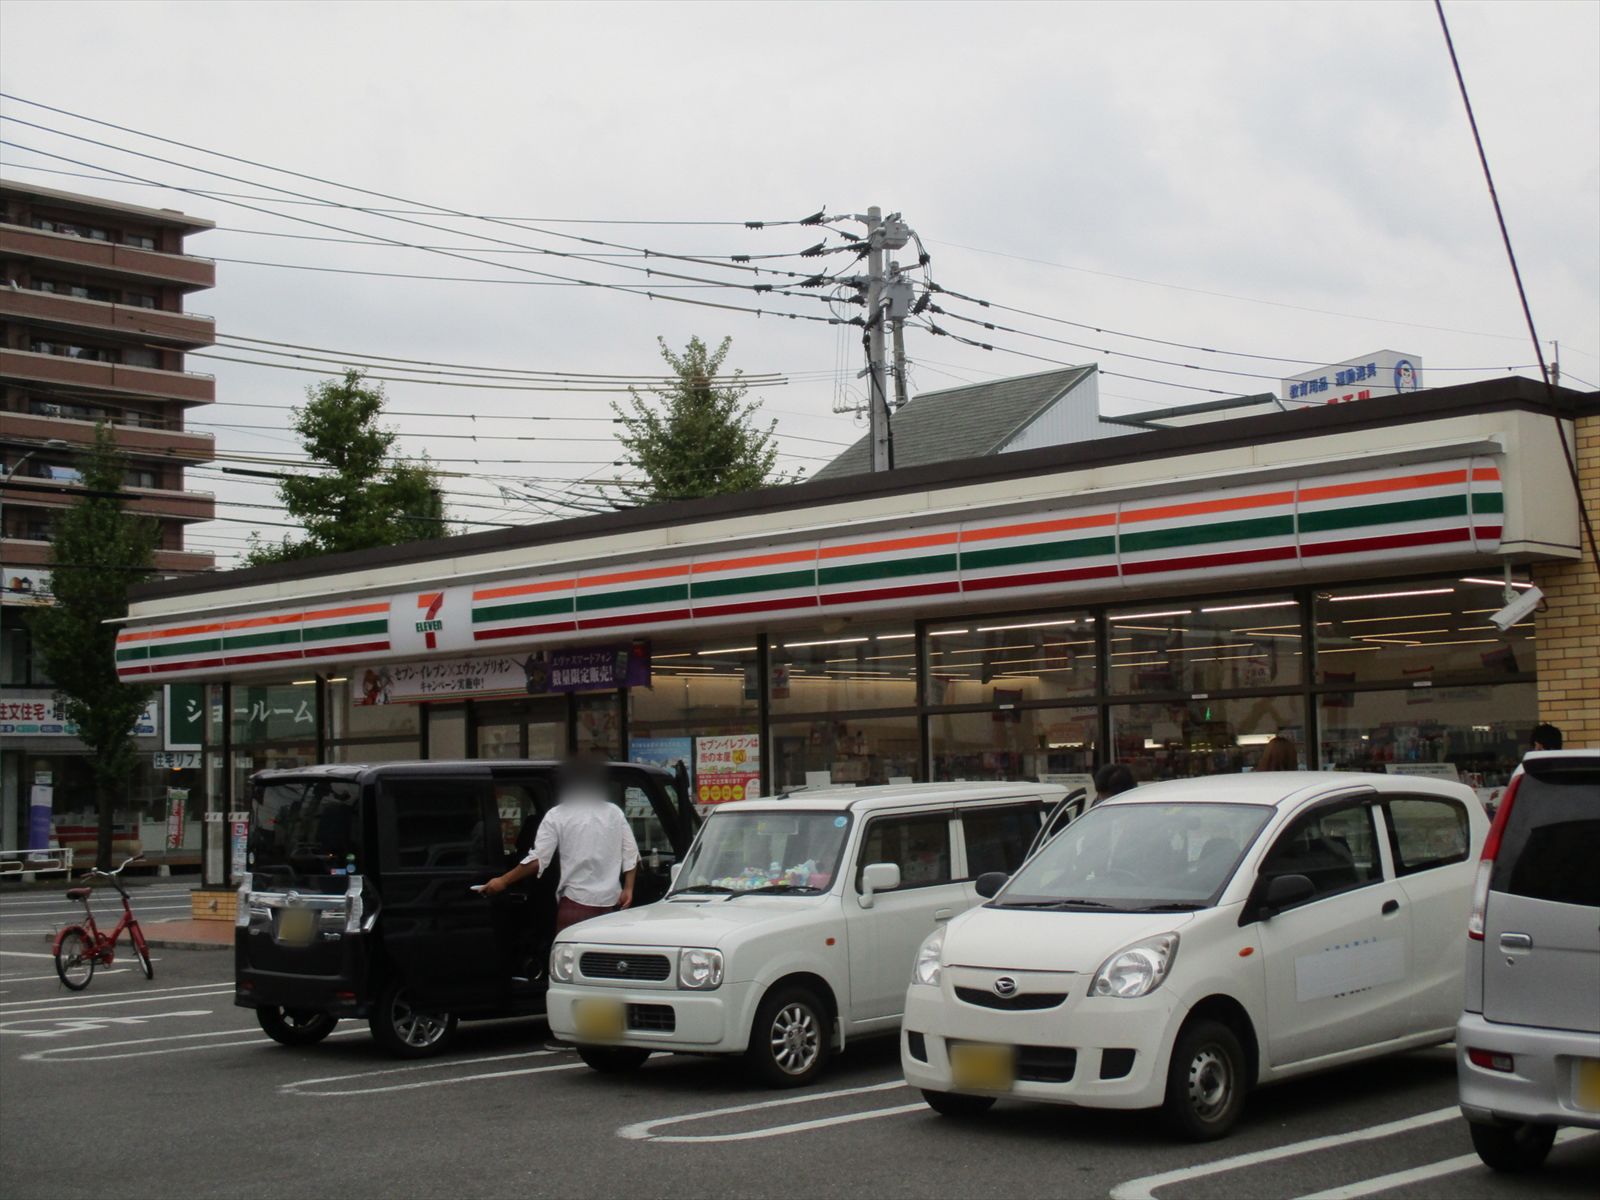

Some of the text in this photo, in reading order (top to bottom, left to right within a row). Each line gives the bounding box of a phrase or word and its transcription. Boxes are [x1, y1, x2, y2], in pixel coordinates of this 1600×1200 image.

[417, 592, 443, 649] 7
[186, 699, 313, 723] ショールーム
